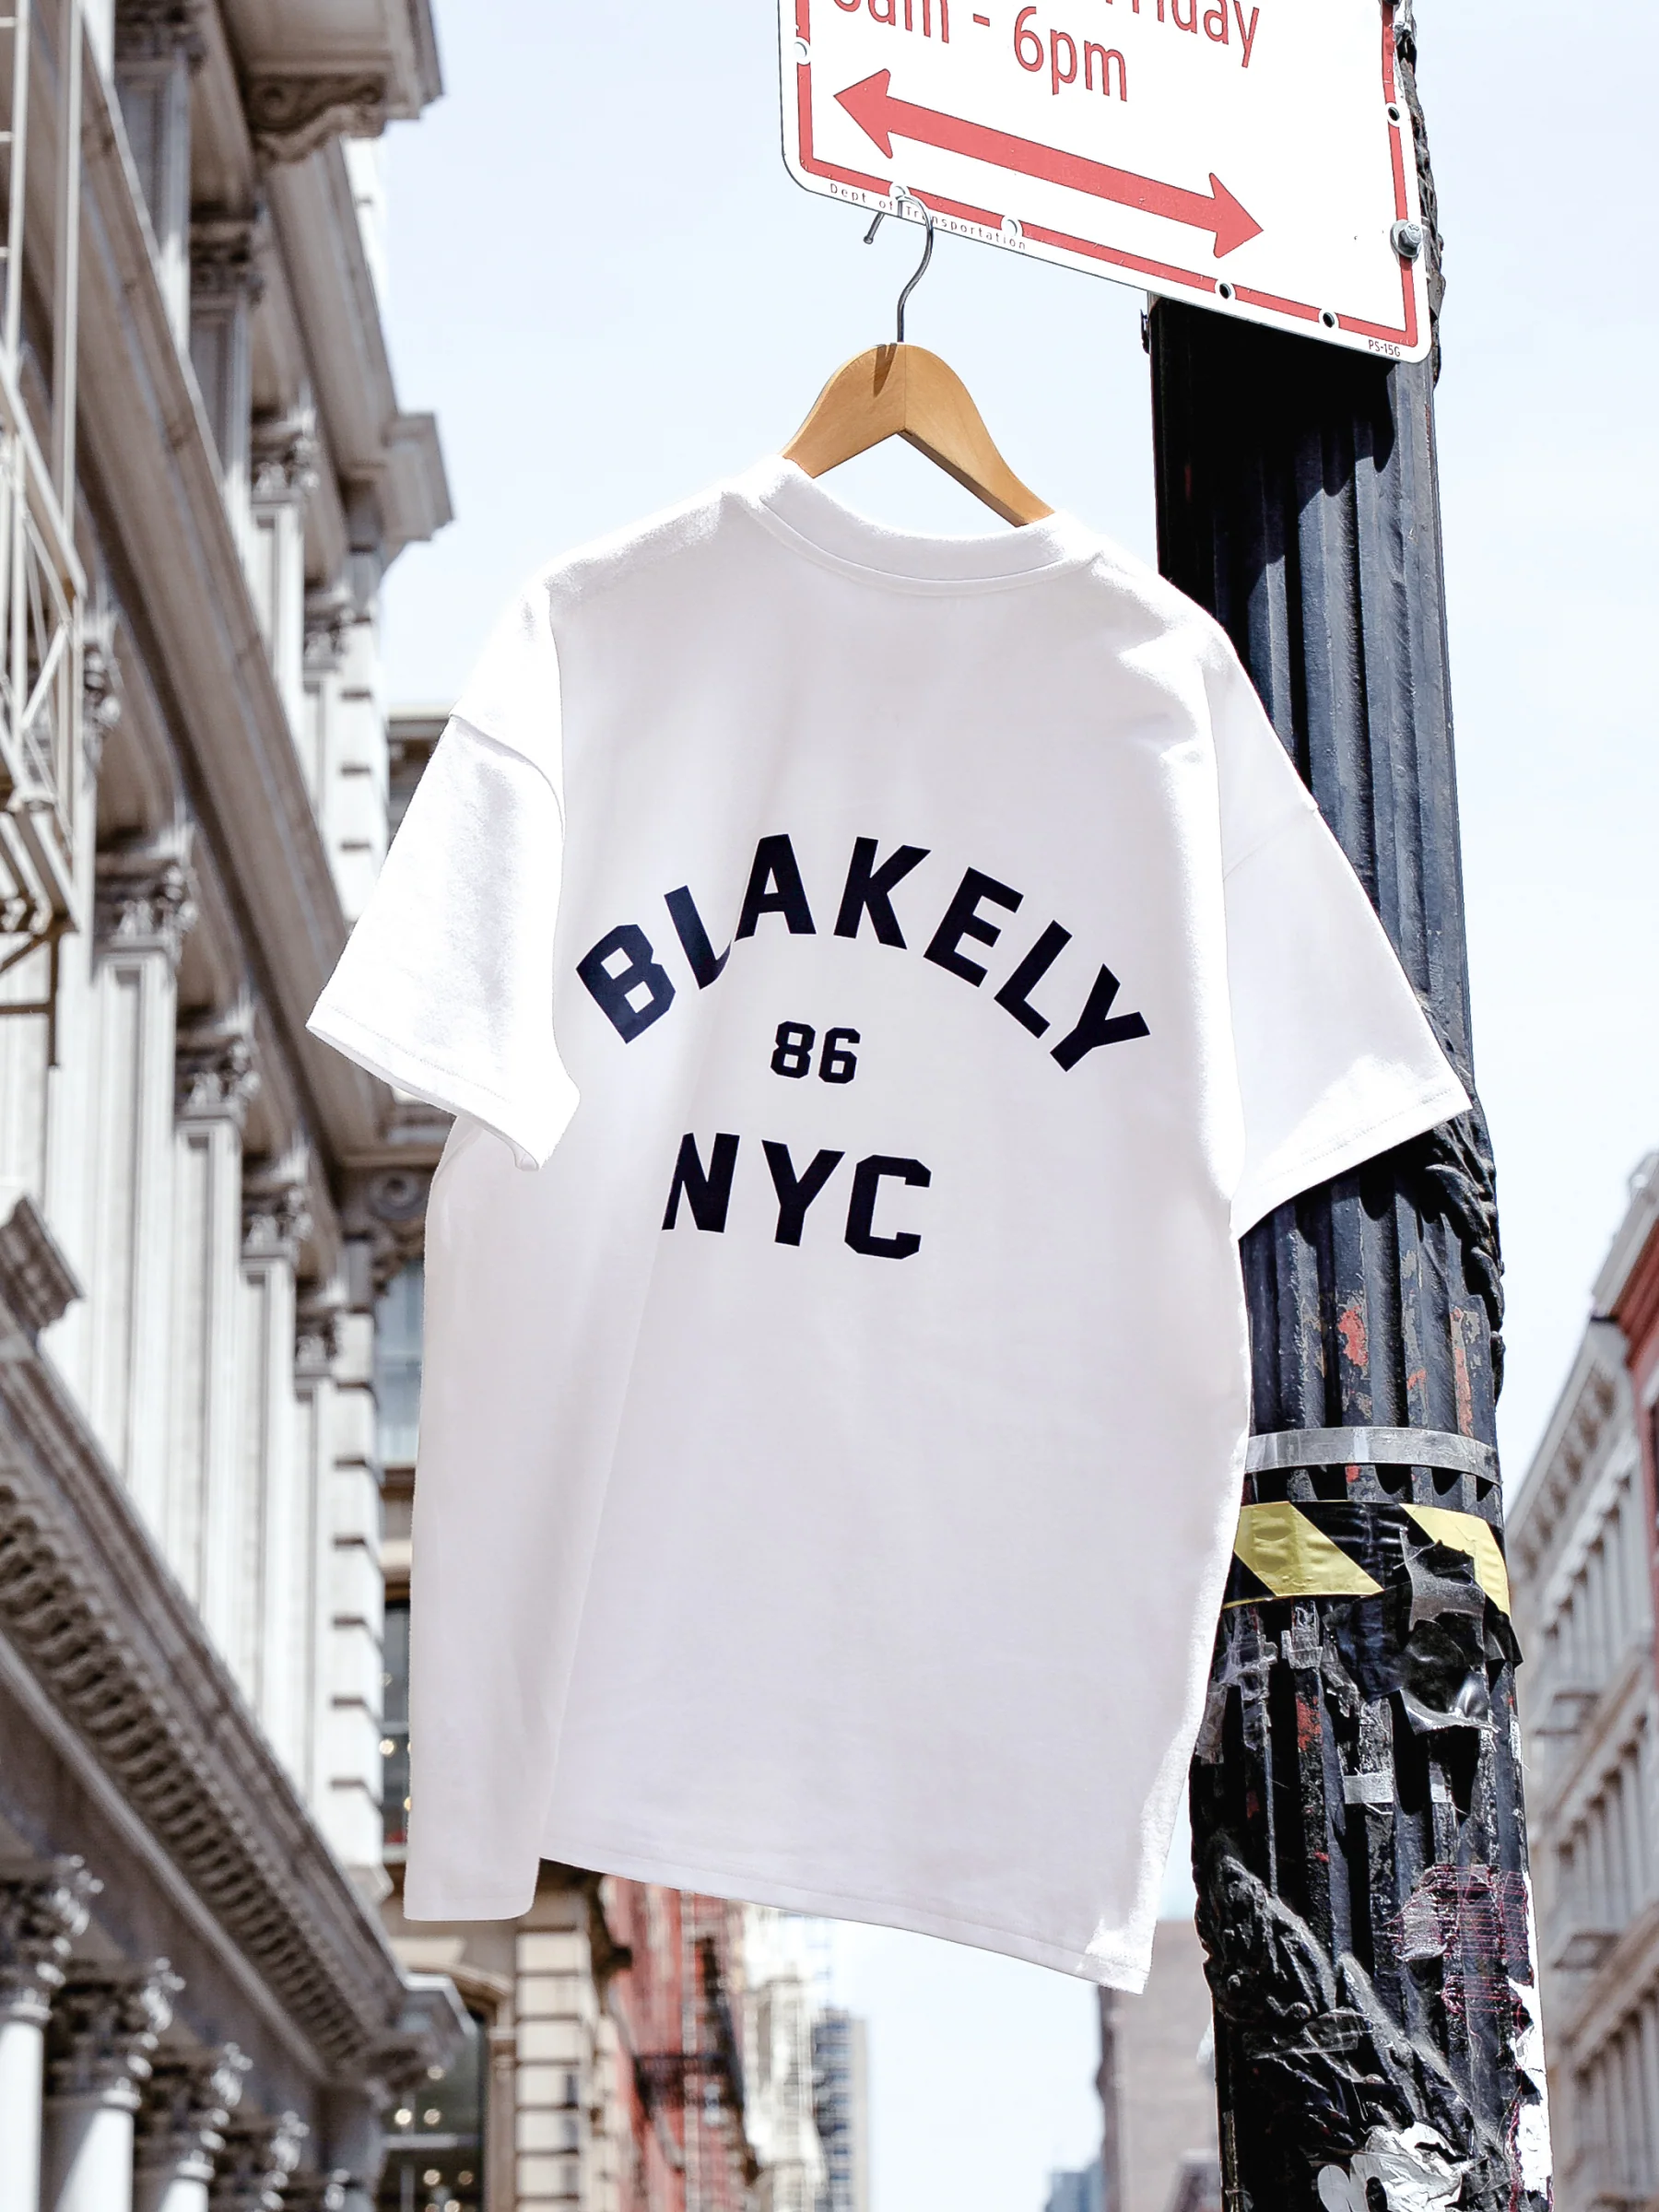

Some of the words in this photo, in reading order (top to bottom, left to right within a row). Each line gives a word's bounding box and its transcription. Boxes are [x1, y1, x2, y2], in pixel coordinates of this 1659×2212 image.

[1014, 6, 1127, 101] 6pm
[830, 183, 866, 204] Dept
[878, 200, 893, 211] of
[1368, 339, 1401, 358] PS-15G
[575, 833, 1151, 1073] BLAKELY
[771, 1020, 861, 1084] 86
[662, 1132, 931, 1259] NYC
